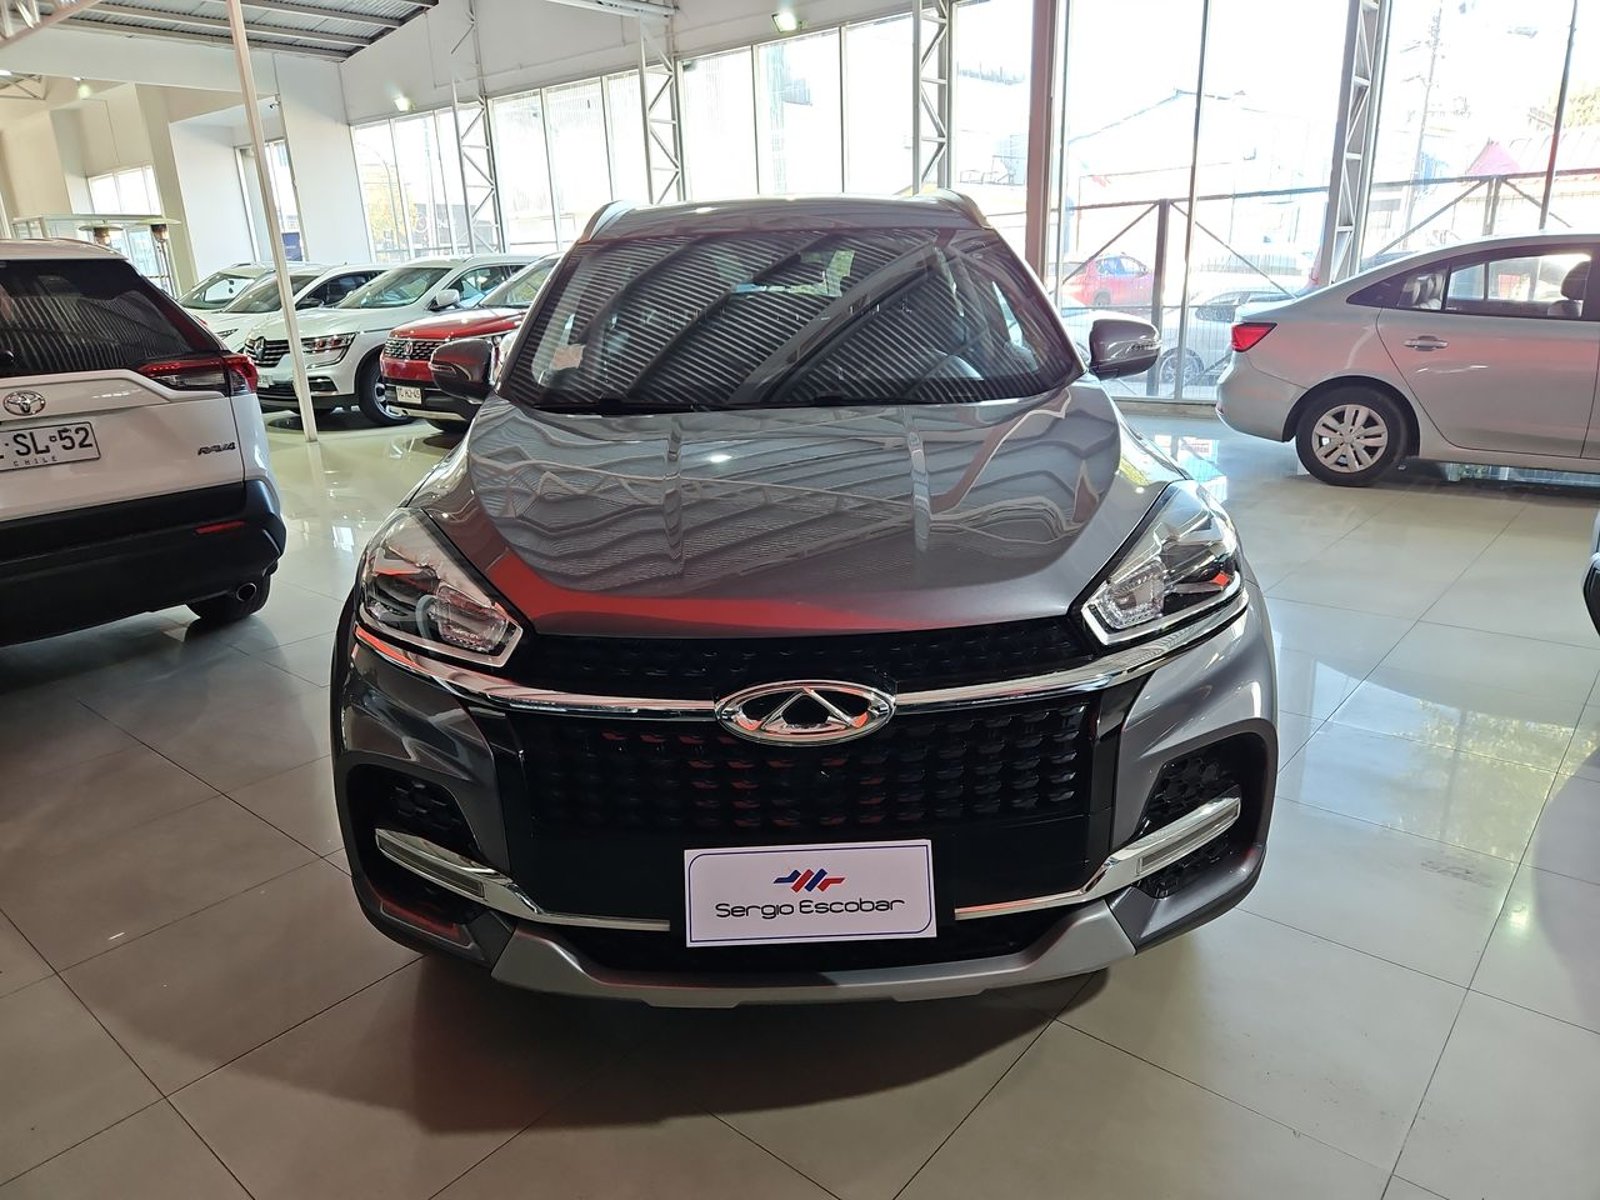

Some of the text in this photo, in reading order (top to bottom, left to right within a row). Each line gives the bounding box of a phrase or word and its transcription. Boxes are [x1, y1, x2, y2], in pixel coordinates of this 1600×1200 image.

[13, 456, 57, 467] CHILE
[715, 897, 905, 920] Sergio Escobar
